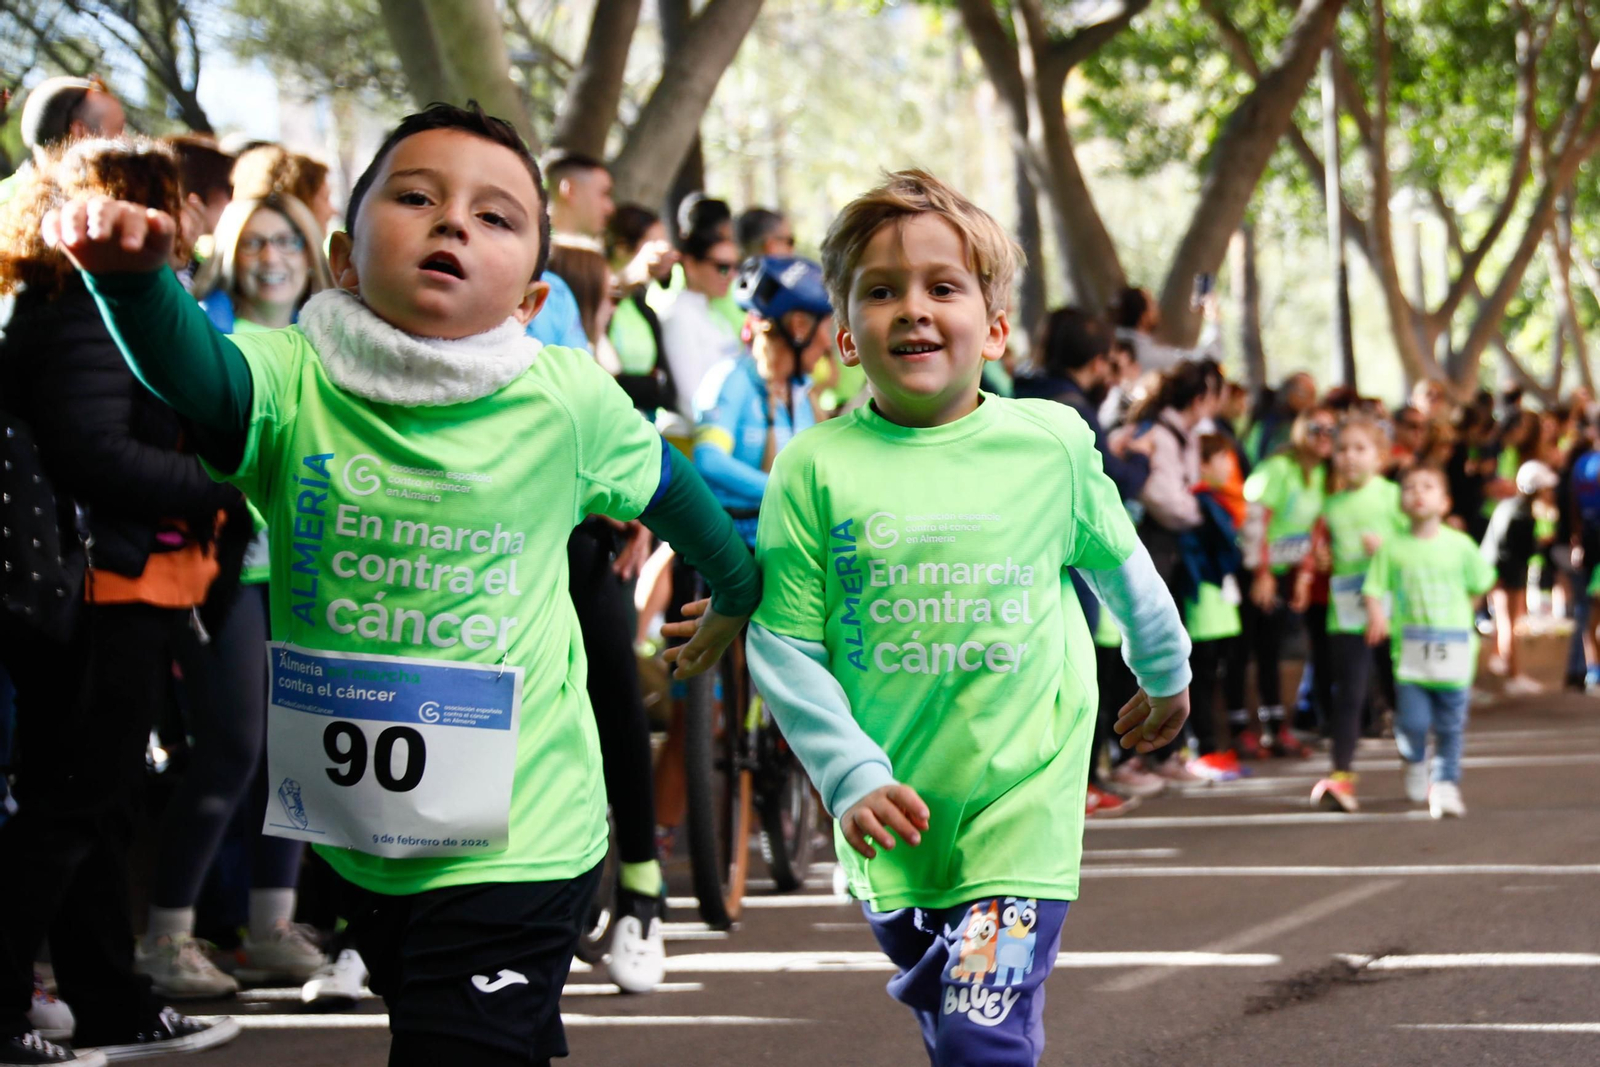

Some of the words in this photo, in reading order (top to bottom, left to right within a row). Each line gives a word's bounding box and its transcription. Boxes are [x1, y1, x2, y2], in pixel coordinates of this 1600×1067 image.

[386, 488, 399, 497] en
[401, 488, 441, 503] Almería
[388, 476, 422, 487] contra
[424, 479, 434, 489] el
[292, 453, 335, 627] ALMERÍA
[335, 504, 383, 541] En
[393, 519, 526, 555] marcha
[906, 536, 918, 544] en
[331, 550, 476, 595] contra
[484, 559, 522, 597] el
[867, 558, 908, 588] En
[918, 556, 1035, 586] marcha
[325, 591, 519, 651] cáncer
[869, 590, 991, 624] contra
[1001, 590, 1034, 624] el
[873, 630, 1028, 675] cáncer
[1421, 643, 1448, 661] 15
[279, 655, 323, 677] Almería
[327, 667, 347, 678] en
[352, 668, 421, 685] marcha
[278, 677, 314, 695] contra
[317, 683, 332, 697] el
[336, 684, 397, 702] cáncer
[322, 720, 427, 793] 90
[372, 834, 379, 844] 9
[381, 833, 395, 844] de
[397, 835, 440, 846] febrero
[443, 837, 458, 847] de
[461, 838, 489, 847] 2025
[943, 984, 1021, 1027] BLUEY
